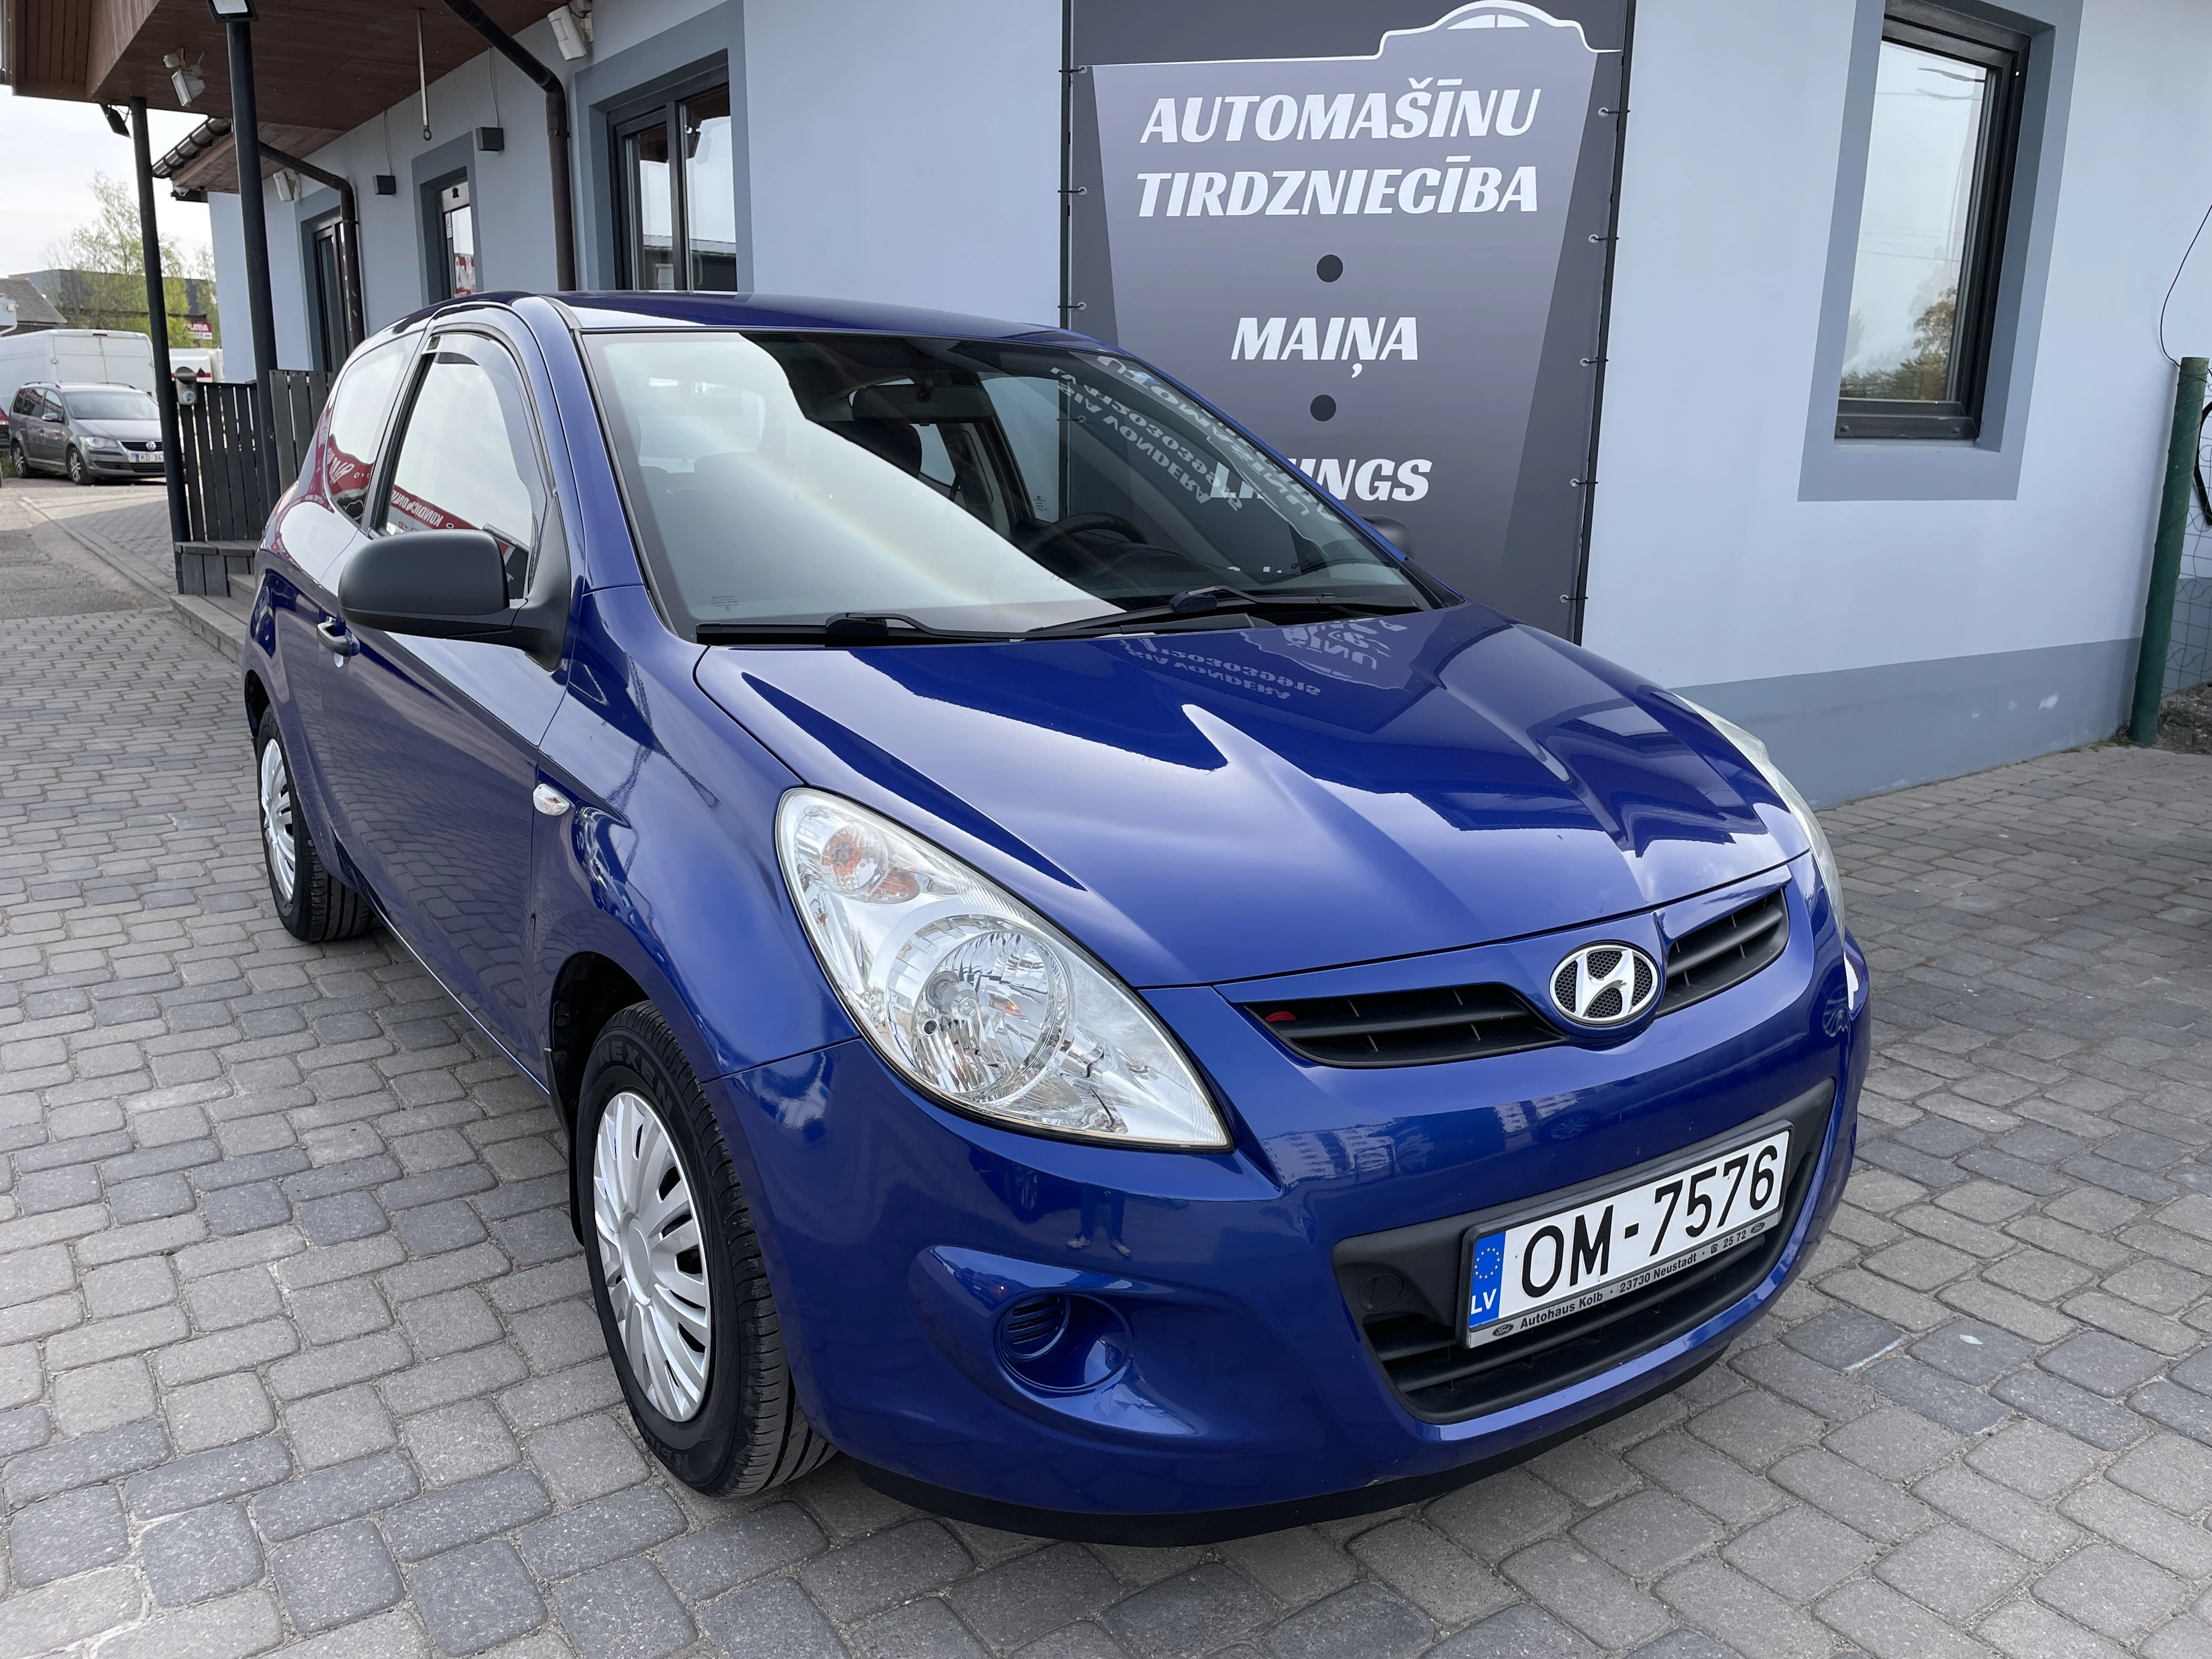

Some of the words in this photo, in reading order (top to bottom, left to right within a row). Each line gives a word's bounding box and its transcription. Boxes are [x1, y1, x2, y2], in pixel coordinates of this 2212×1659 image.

[1140, 77, 1541, 144] AUTOMAŠĪNU
[1137, 155, 1538, 218] TIRDZNIECĪBA
[1230, 316, 1418, 380] MAIŅA
[1210, 458, 1433, 501] LNGS
[598, 1040, 674, 1119] NEXEN
[1521, 1144, 1779, 1299] OM-7576
[1470, 1288, 1497, 1315] LV
[1520, 1302, 1576, 1330] Autohaus
[1579, 1291, 1603, 1308] Kolb
[1619, 1272, 1651, 1294] 23730
[1653, 1252, 1697, 1280] Neustadt
[1723, 1237, 1734, 1249] 25
[1736, 1229, 1747, 1243] 72
